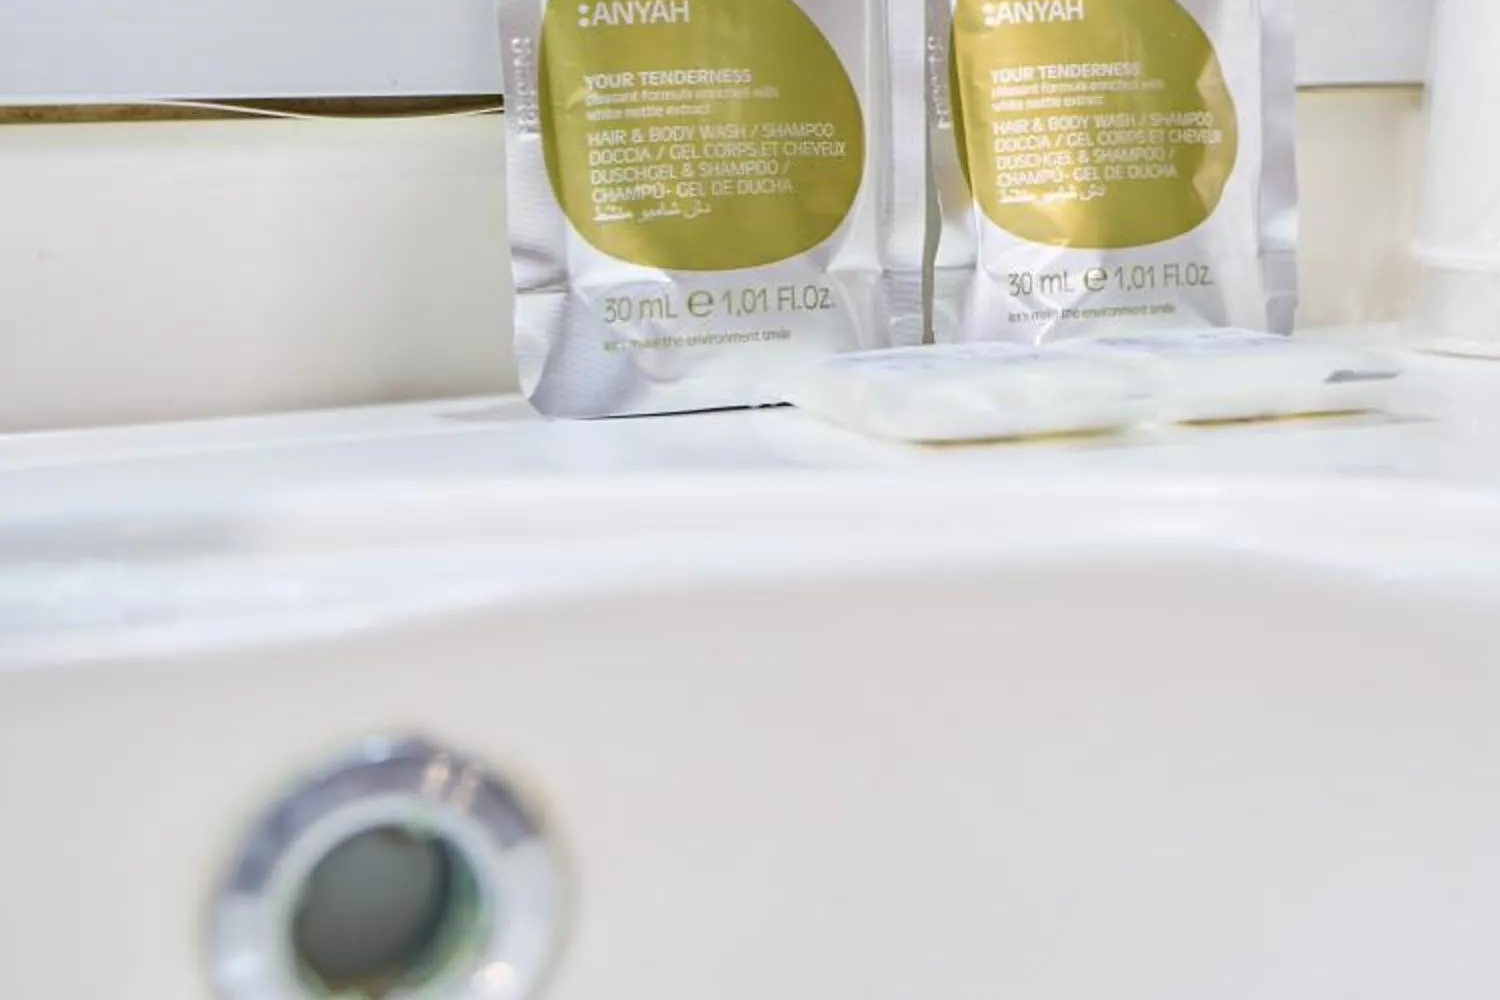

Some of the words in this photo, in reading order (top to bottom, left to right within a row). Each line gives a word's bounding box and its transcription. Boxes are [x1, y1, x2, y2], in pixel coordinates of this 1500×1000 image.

[584, 72, 636, 90] YOUR
[639, 69, 753, 87] TENDERNESS
[990, 66, 1035, 83] YOUR
[1039, 62, 1142, 81] TENDERNESS
[587, 130, 628, 148] HAIR
[632, 128, 645, 145] &
[649, 125, 696, 143] BODY
[701, 123, 748, 141] WASH
[762, 123, 836, 139] SHAMPOO
[993, 119, 1031, 136] HAIR
[1033, 118, 1045, 133] &
[1048, 116, 1090, 131] BODY
[1095, 113, 1137, 129] WASH
[1150, 111, 1215, 128] SHAMPOO
[995, 135, 1052, 153] DOCCIA
[1068, 132, 1096, 148] GEL
[1097, 130, 1147, 147] CORPS
[1150, 129, 1166, 145] ET
[590, 148, 653, 166] DOCCIA
[670, 143, 702, 160] GEL
[704, 142, 759, 159] CORPS
[762, 142, 782, 157] ET
[996, 151, 1075, 171] DUSCHGEL
[1077, 149, 1090, 165] &
[1093, 147, 1167, 164] SHAMPOO
[591, 164, 679, 186] DUSCHGEL
[683, 161, 696, 178] &
[699, 160, 780, 178] SHAMPOO
[1073, 166, 1102, 183] GEL
[1106, 164, 1126, 181] DE
[1128, 162, 1179, 180] DUCHA
[676, 181, 707, 198] GEL
[712, 180, 734, 196] DE
[738, 178, 795, 196] DUCHA
[1008, 273, 1035, 297] 30
[1041, 270, 1078, 294] mL
[1115, 265, 1158, 292] 1,01
[605, 298, 634, 324] 30
[640, 294, 679, 320] mL
[722, 287, 769, 317] 1,01
